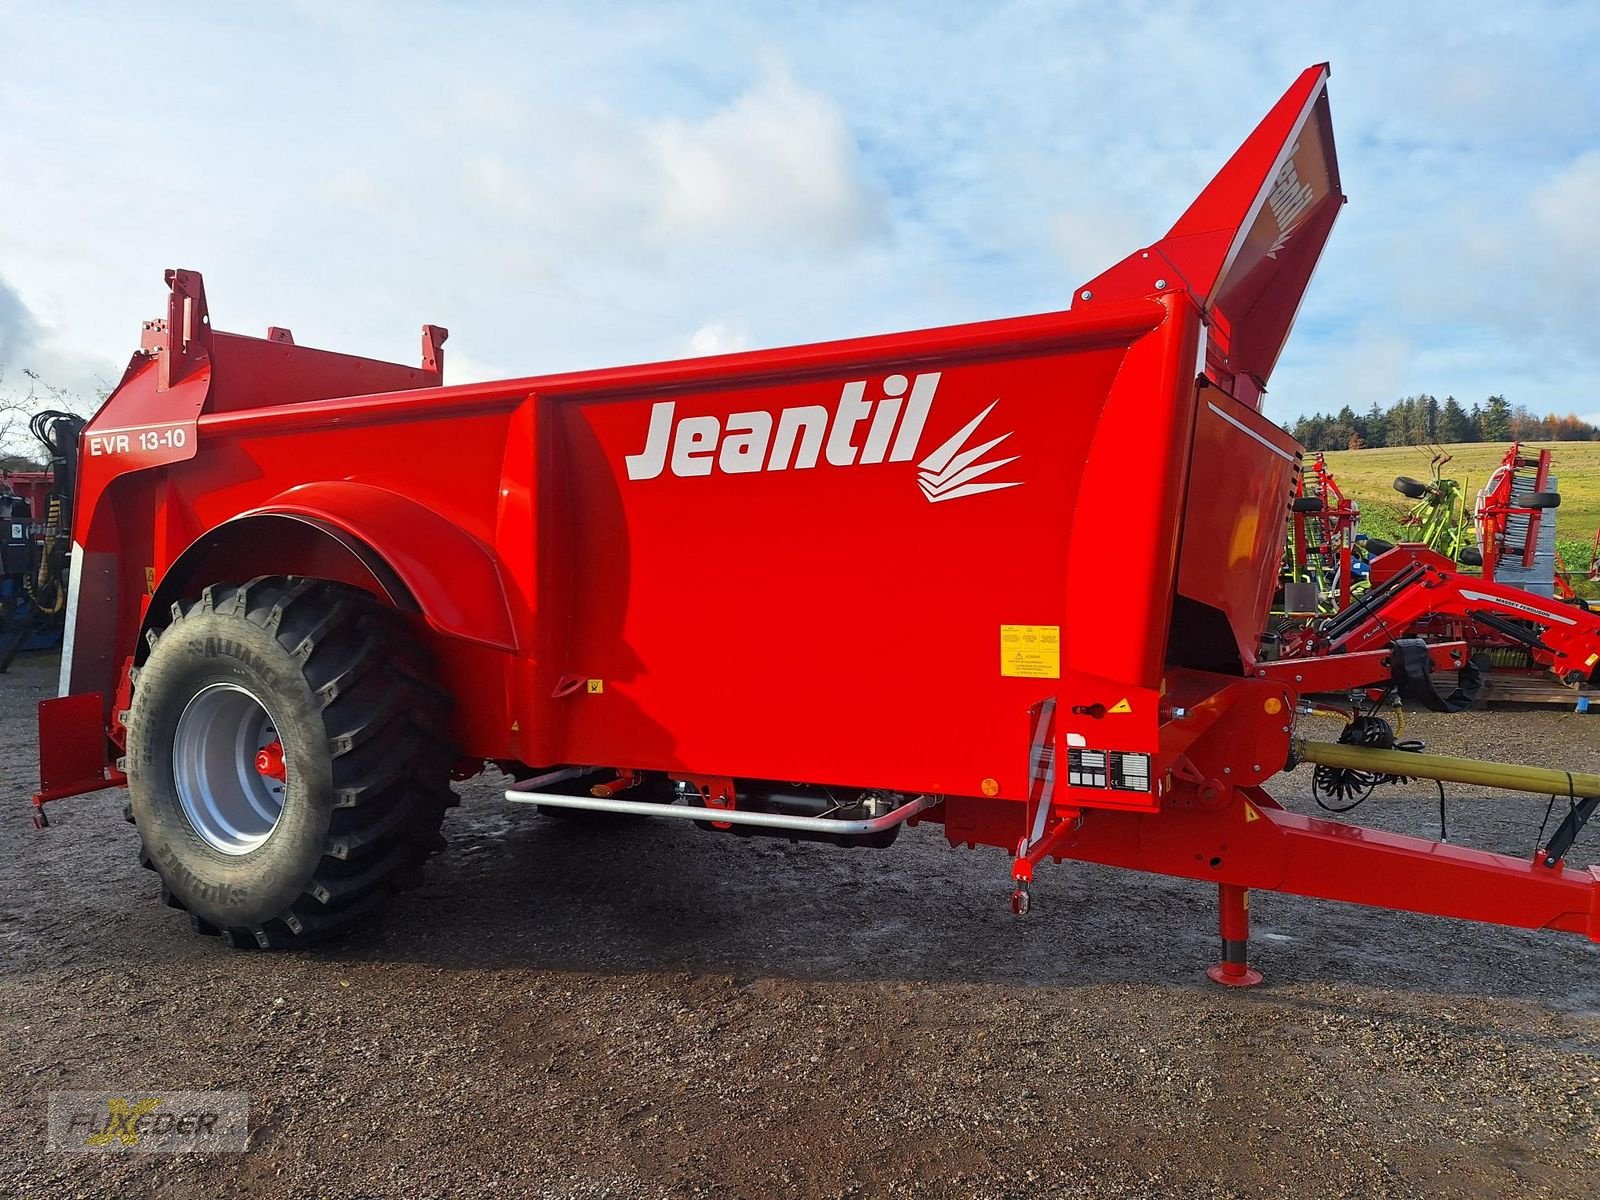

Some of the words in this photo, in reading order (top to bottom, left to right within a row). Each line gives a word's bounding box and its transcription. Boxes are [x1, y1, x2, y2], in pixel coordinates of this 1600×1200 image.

[624, 371, 942, 481] Jeantil
[90, 434, 130, 456] EVR
[139, 428, 186, 451] 13-10
[1496, 598, 1519, 608] MASSEY
[1520, 605, 1551, 617] FERGUSON
